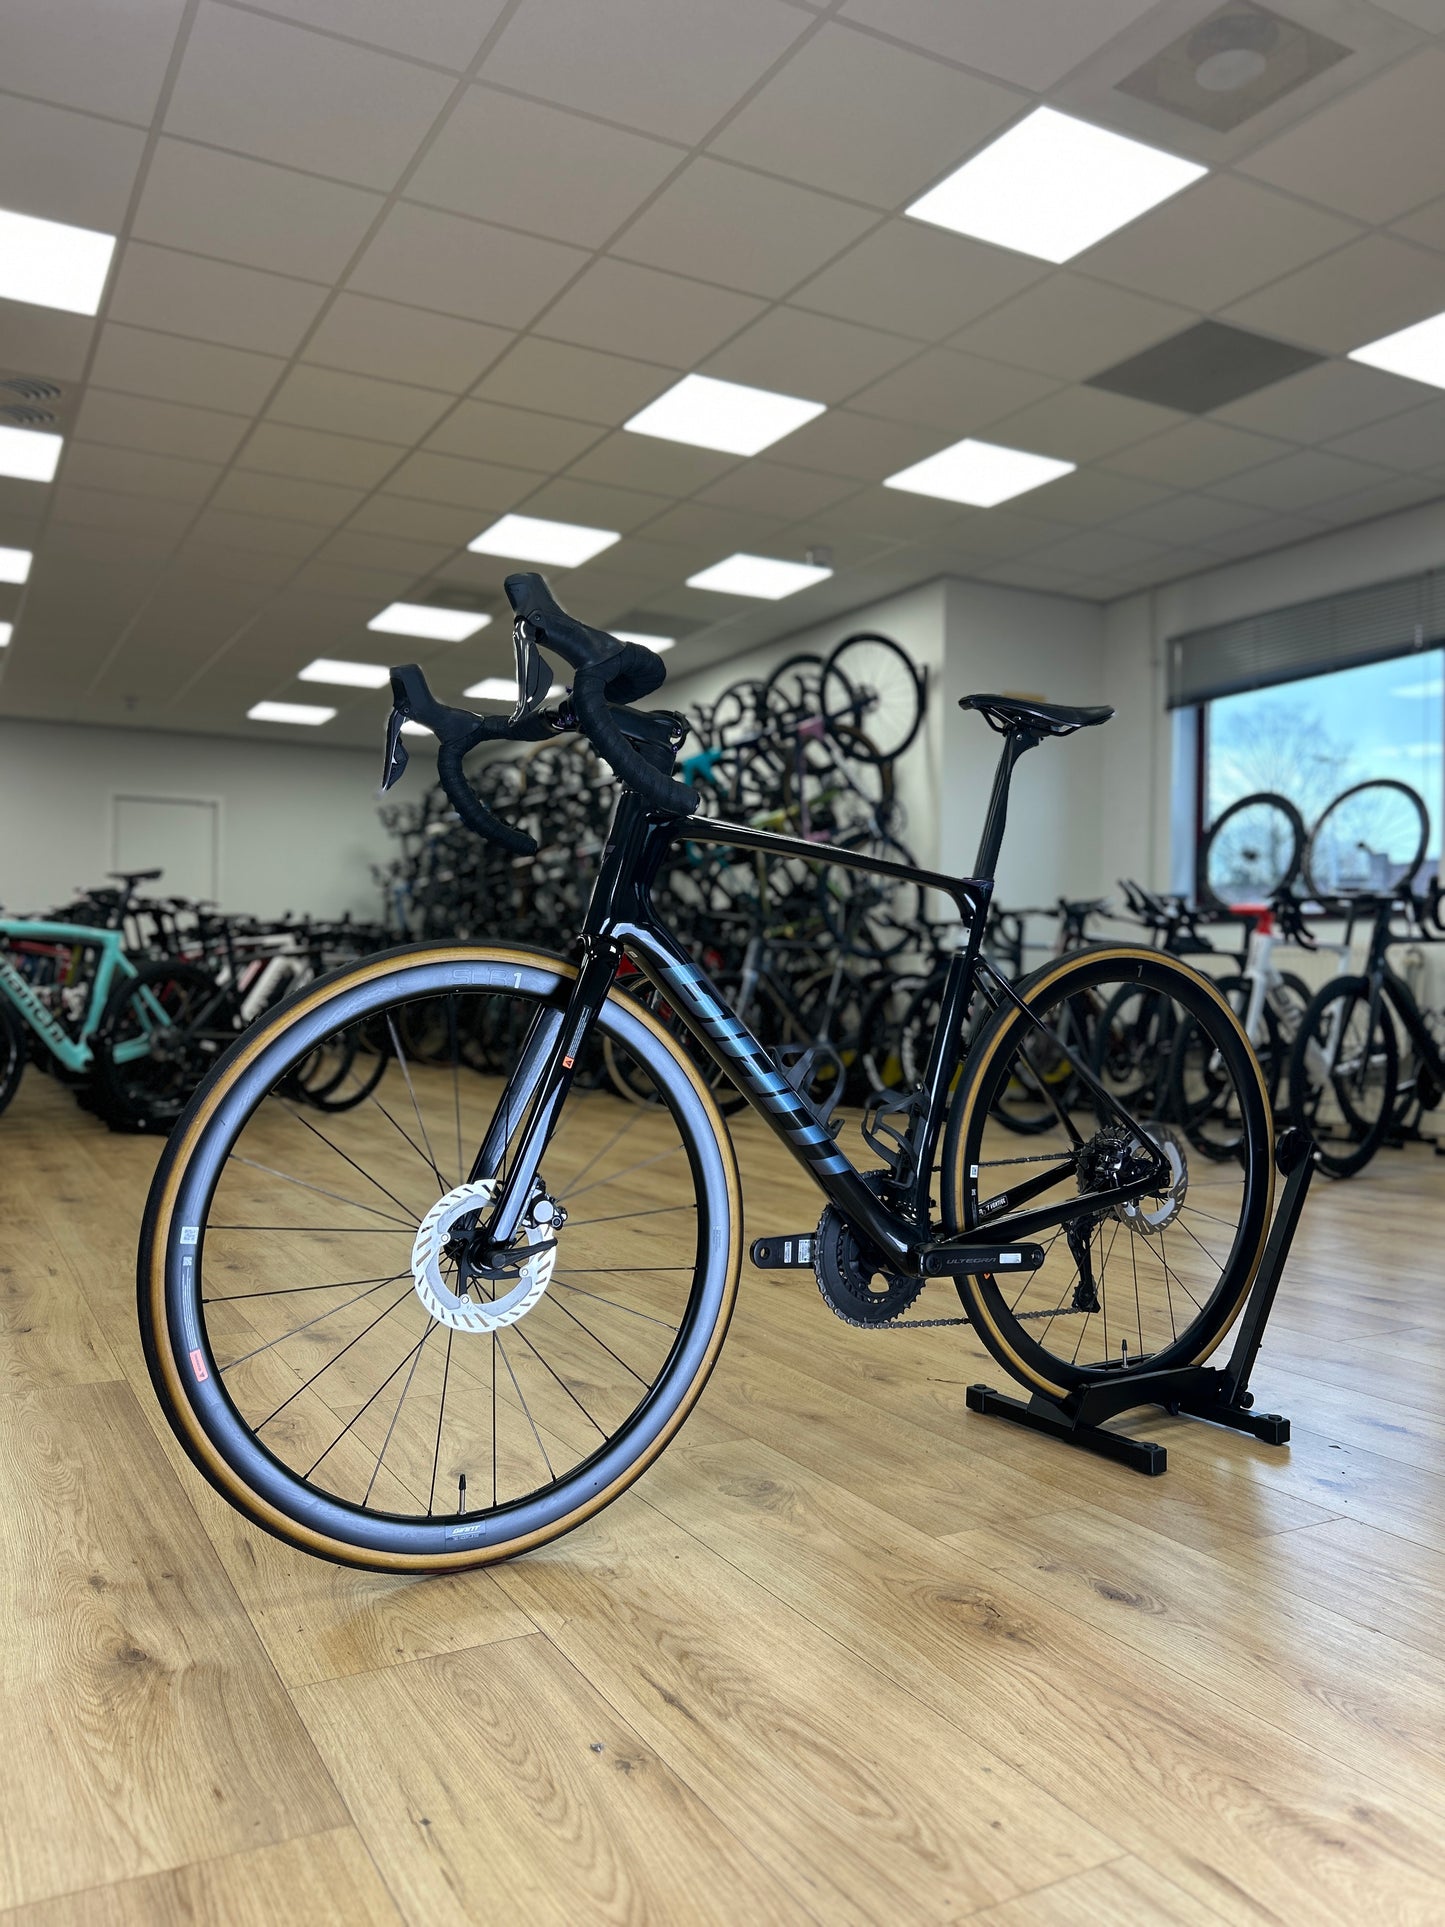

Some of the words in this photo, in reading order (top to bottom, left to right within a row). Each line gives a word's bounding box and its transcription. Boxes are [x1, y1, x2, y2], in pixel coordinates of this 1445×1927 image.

[0, 961, 65, 1044] ianchi
[659, 963, 852, 1176] GIANT
[946, 1257, 997, 1265] ULTEGRA
